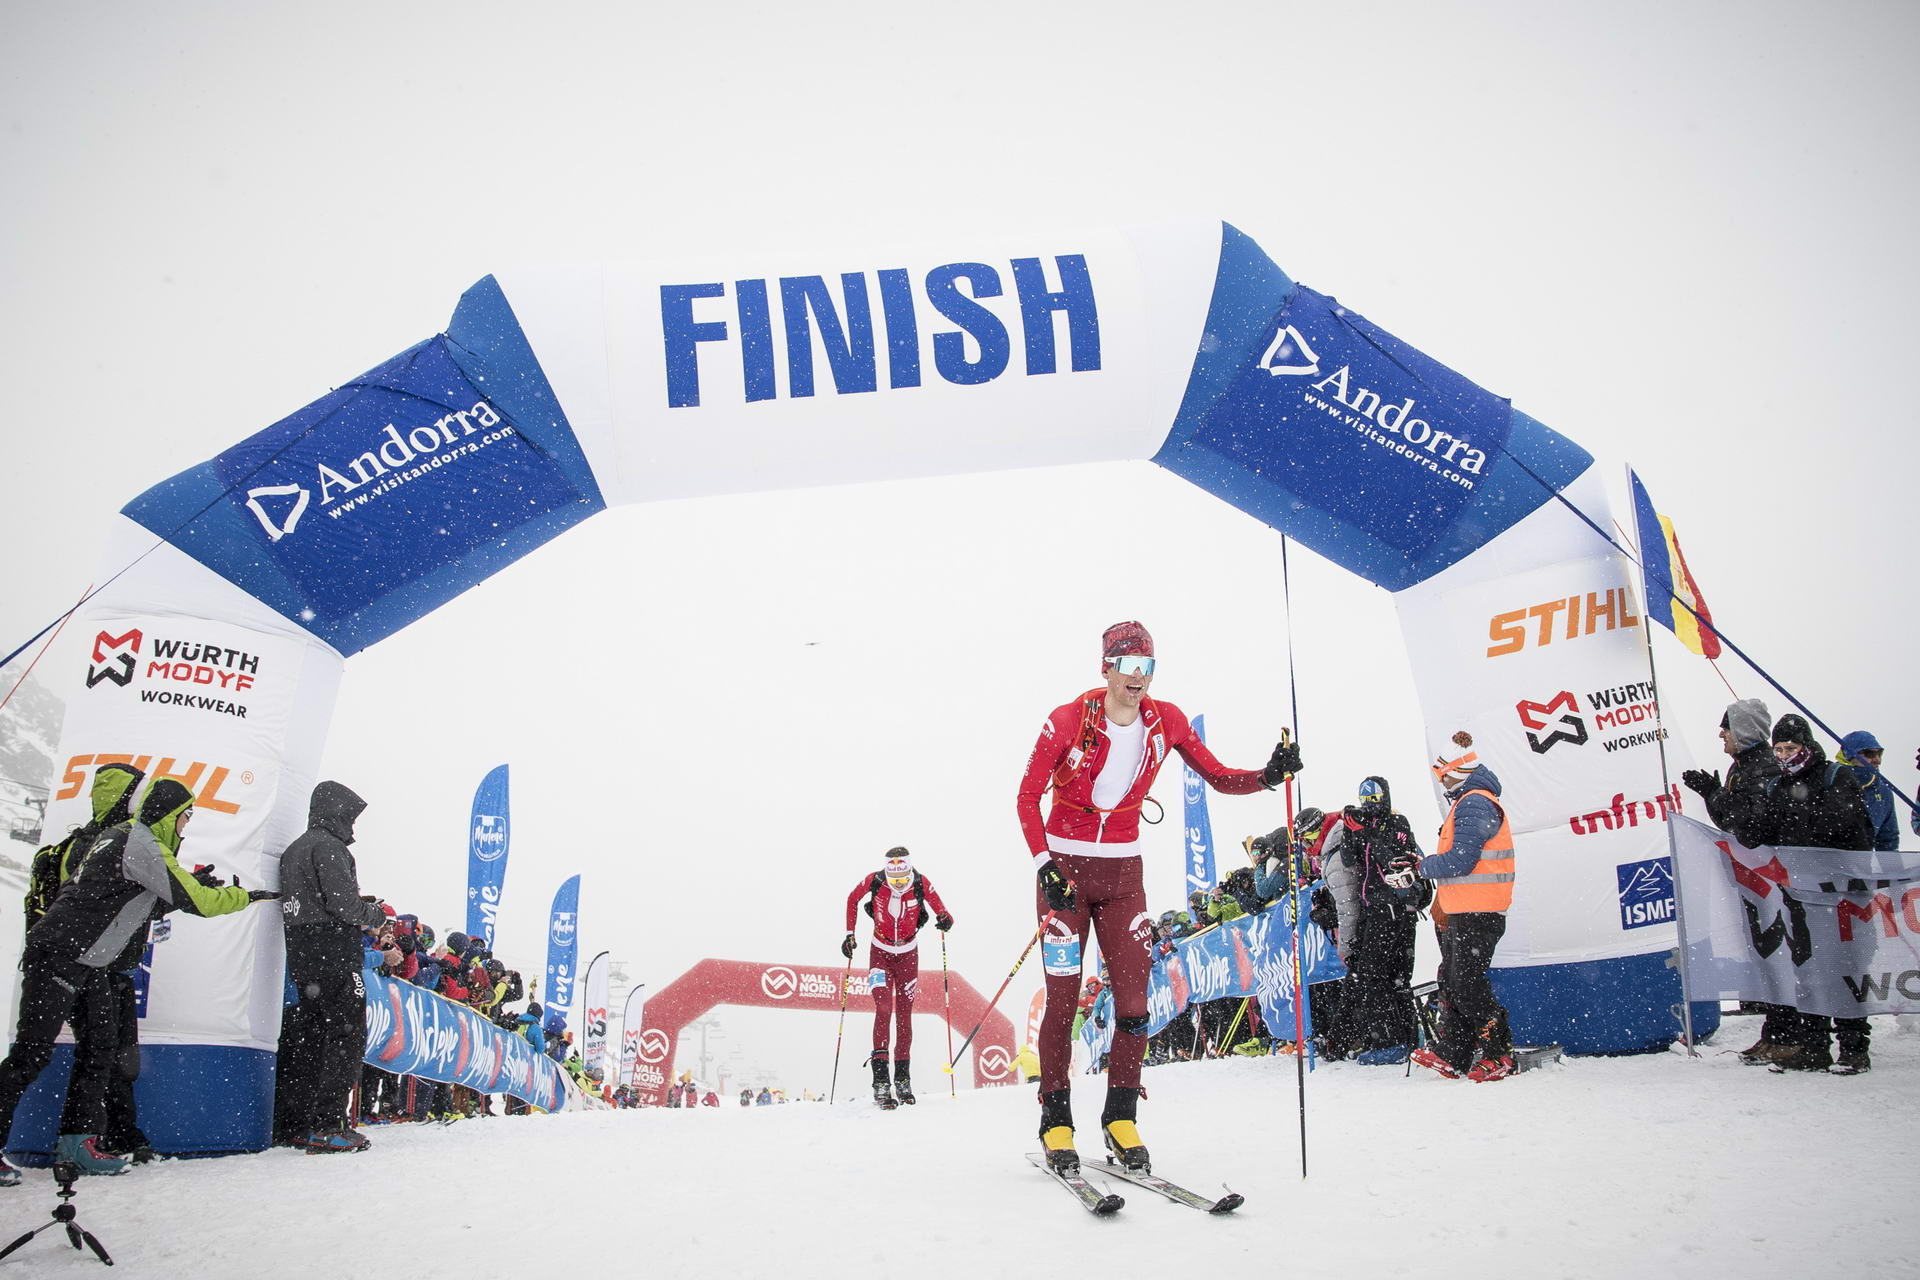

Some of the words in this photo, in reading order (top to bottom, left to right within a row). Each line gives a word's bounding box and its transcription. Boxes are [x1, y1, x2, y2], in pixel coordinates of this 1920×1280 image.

[660, 254, 1101, 408] FINISH
[1311, 365, 1487, 475] Andorra
[317, 400, 501, 506] Andorra
[1303, 392, 1475, 491] www.visitandorra.com
[327, 426, 517, 519] www.visitandorra.com
[1487, 587, 1639, 658] STIHL
[154, 639, 260, 675] WÜRTH
[146, 660, 254, 692] MODYF
[141, 690, 248, 719] WORKWEAR
[1587, 681, 1655, 711] WÜRTH
[1602, 728, 1670, 753] WORKWER
[1625, 898, 1675, 925] ISMF
[1057, 948, 1067, 962] 3
[799, 983, 837, 994] NORD
[800, 973, 833, 985] VALL
[633, 1072, 665, 1085] NORD
